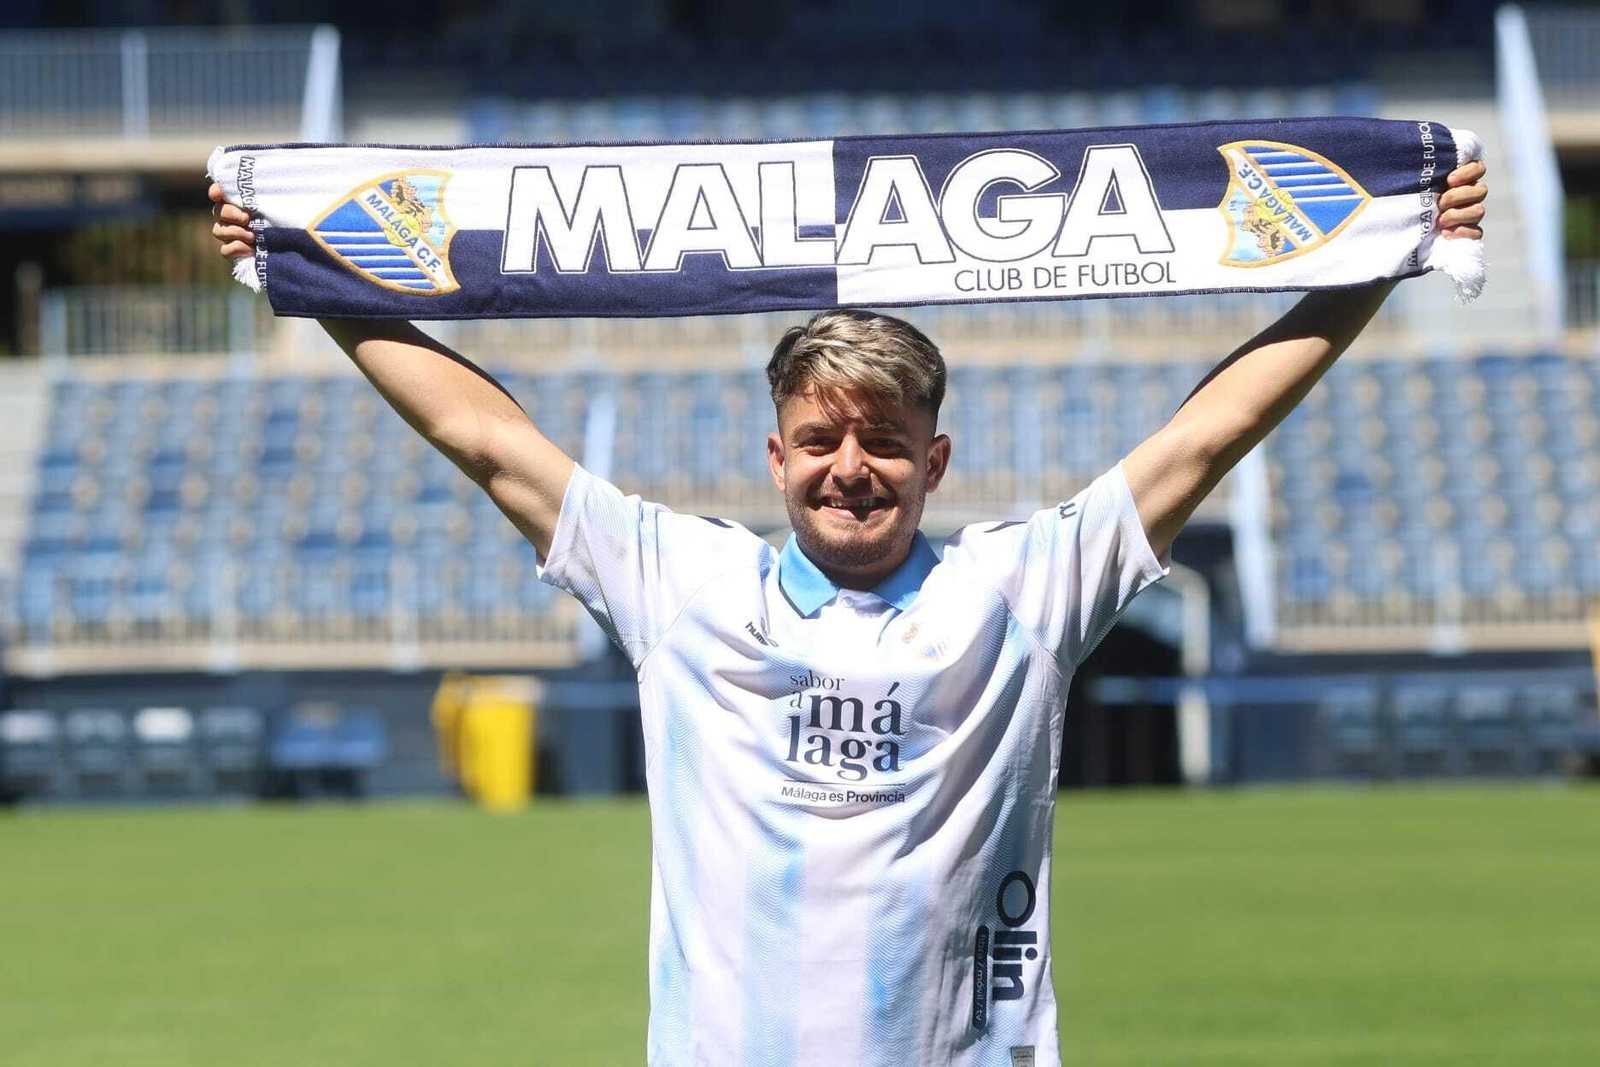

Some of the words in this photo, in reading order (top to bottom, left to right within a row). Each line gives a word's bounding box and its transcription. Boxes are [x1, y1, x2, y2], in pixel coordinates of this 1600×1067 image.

[366, 193, 419, 249] MALAGA
[501, 144, 1175, 274] MALAGA
[1258, 187, 1313, 241] MALAGA
[954, 268, 1023, 292] CLUB
[1034, 266, 1067, 289] DE
[1078, 261, 1176, 287] FUTBOL
[789, 670, 844, 691] sabor
[789, 690, 802, 709] a
[807, 681, 906, 736] má
[786, 715, 903, 781] laga
[781, 786, 827, 802] Málaga
[829, 792, 844, 801] es
[846, 790, 905, 803] Provincia
[992, 870, 1038, 1000] Olin
